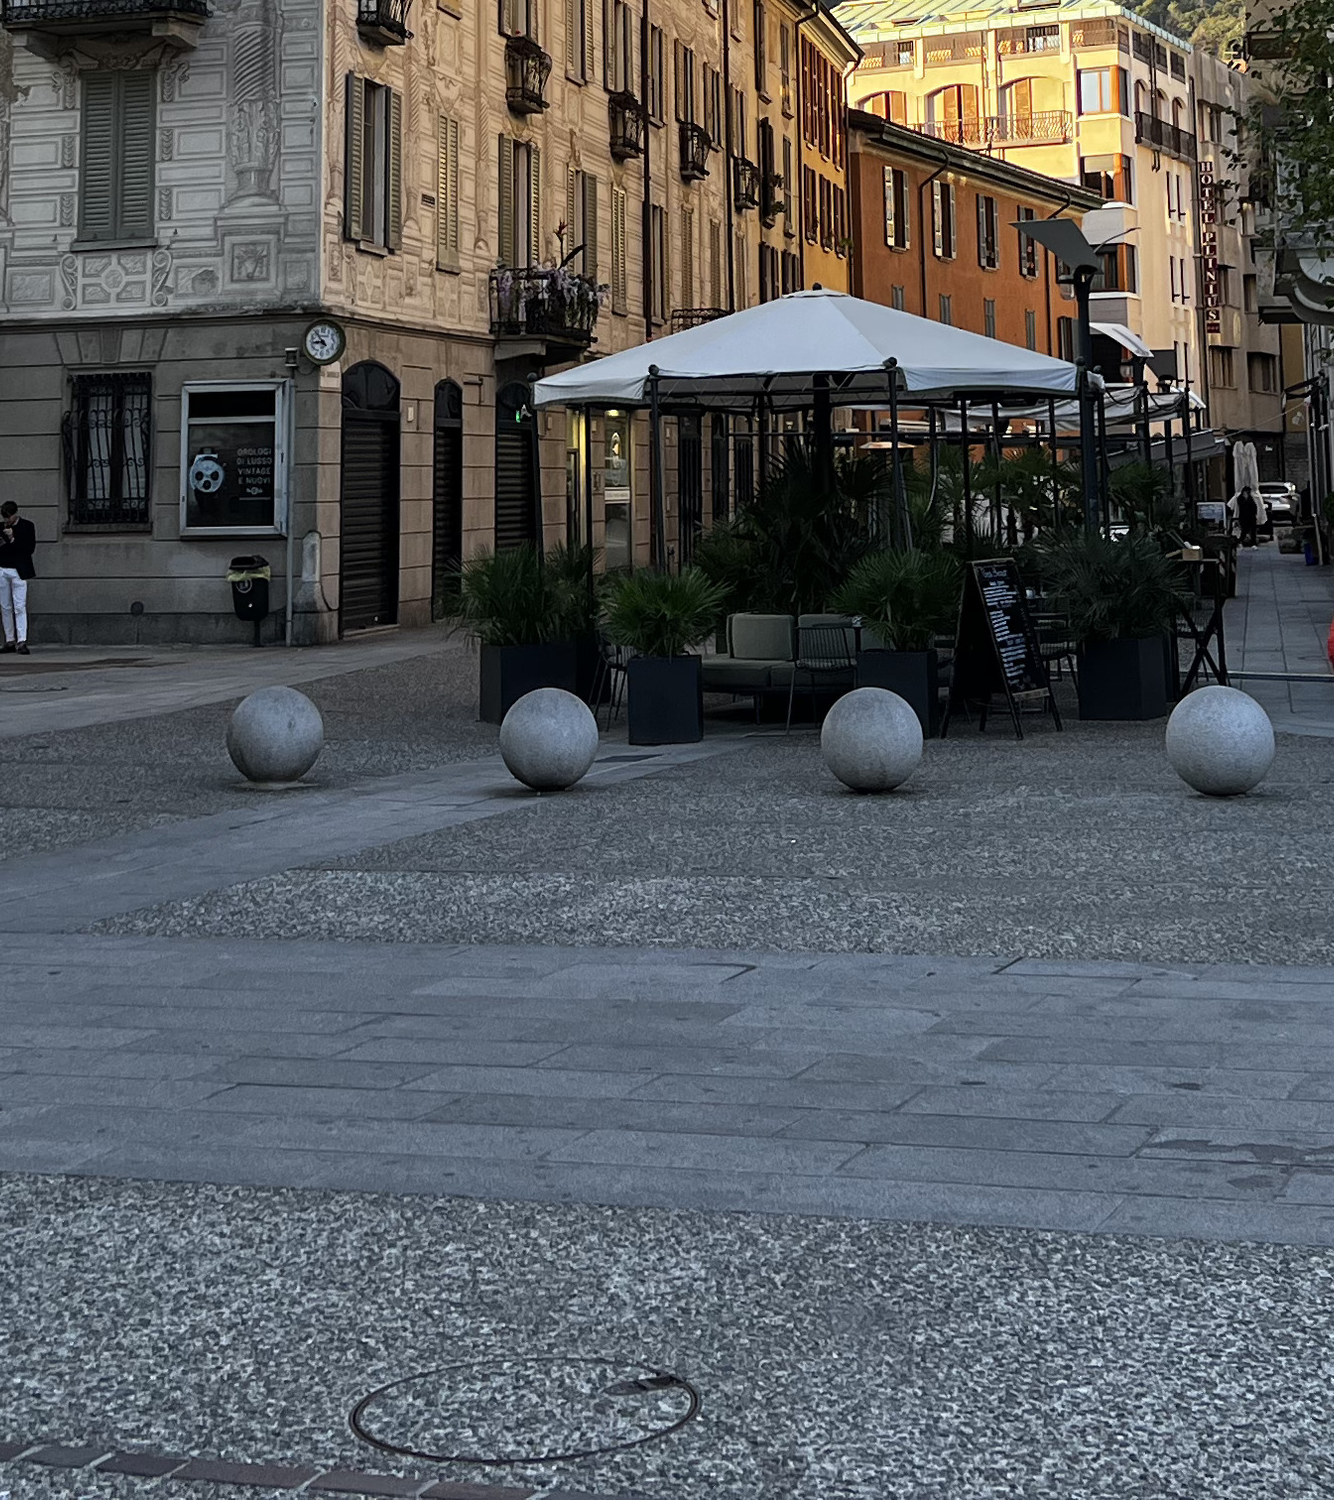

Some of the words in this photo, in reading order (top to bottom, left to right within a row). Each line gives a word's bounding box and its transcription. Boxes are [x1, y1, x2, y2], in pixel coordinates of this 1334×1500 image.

[1200, 161, 1214, 224] HOTEL
[1204, 231, 1218, 321] PLINIUS
[237, 448, 272, 456] OROLOGI
[237, 457, 245, 465] DI
[247, 457, 272, 465] LUSSO
[237, 467, 271, 475] VINTAGE
[246, 476, 271, 485] NUOVI
